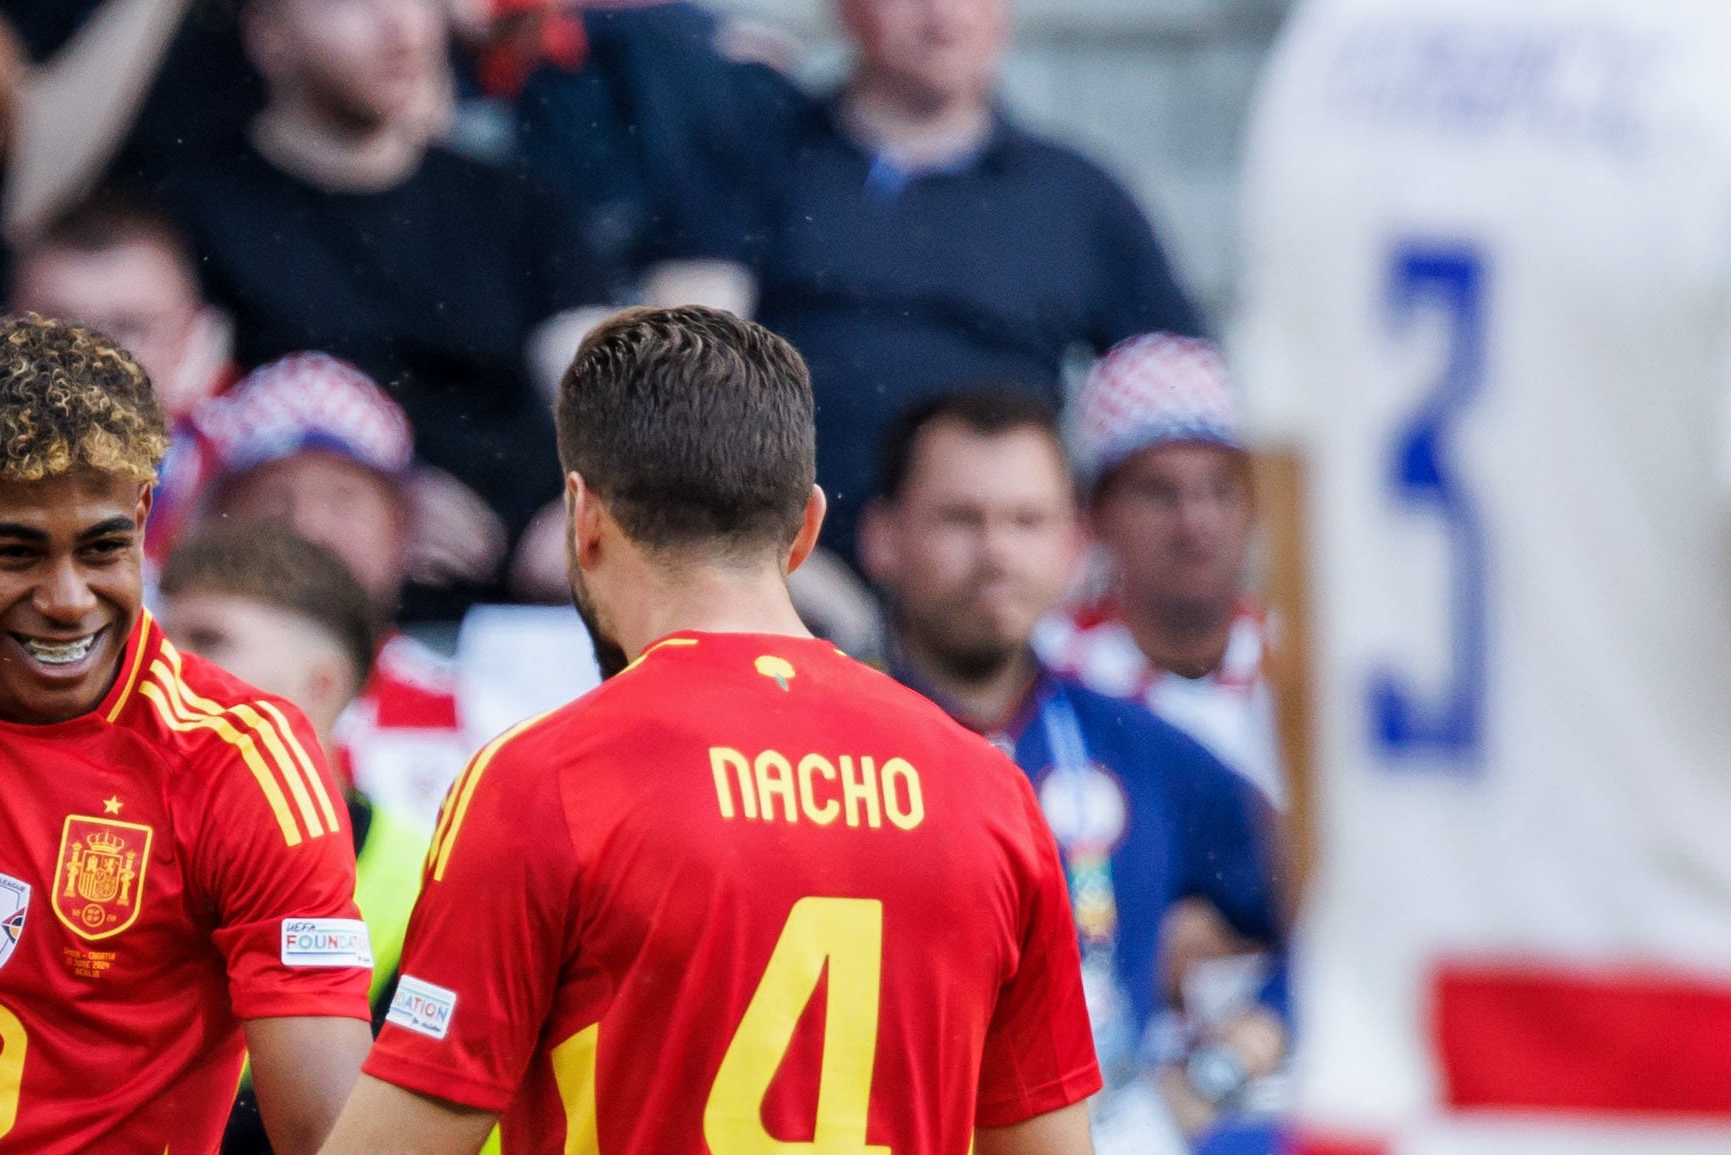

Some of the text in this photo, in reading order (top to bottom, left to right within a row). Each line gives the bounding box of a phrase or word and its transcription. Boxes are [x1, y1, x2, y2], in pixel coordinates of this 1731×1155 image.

[1376, 243, 1490, 768] 3
[709, 746, 925, 830] NACHO
[286, 922, 316, 932] UEFA
